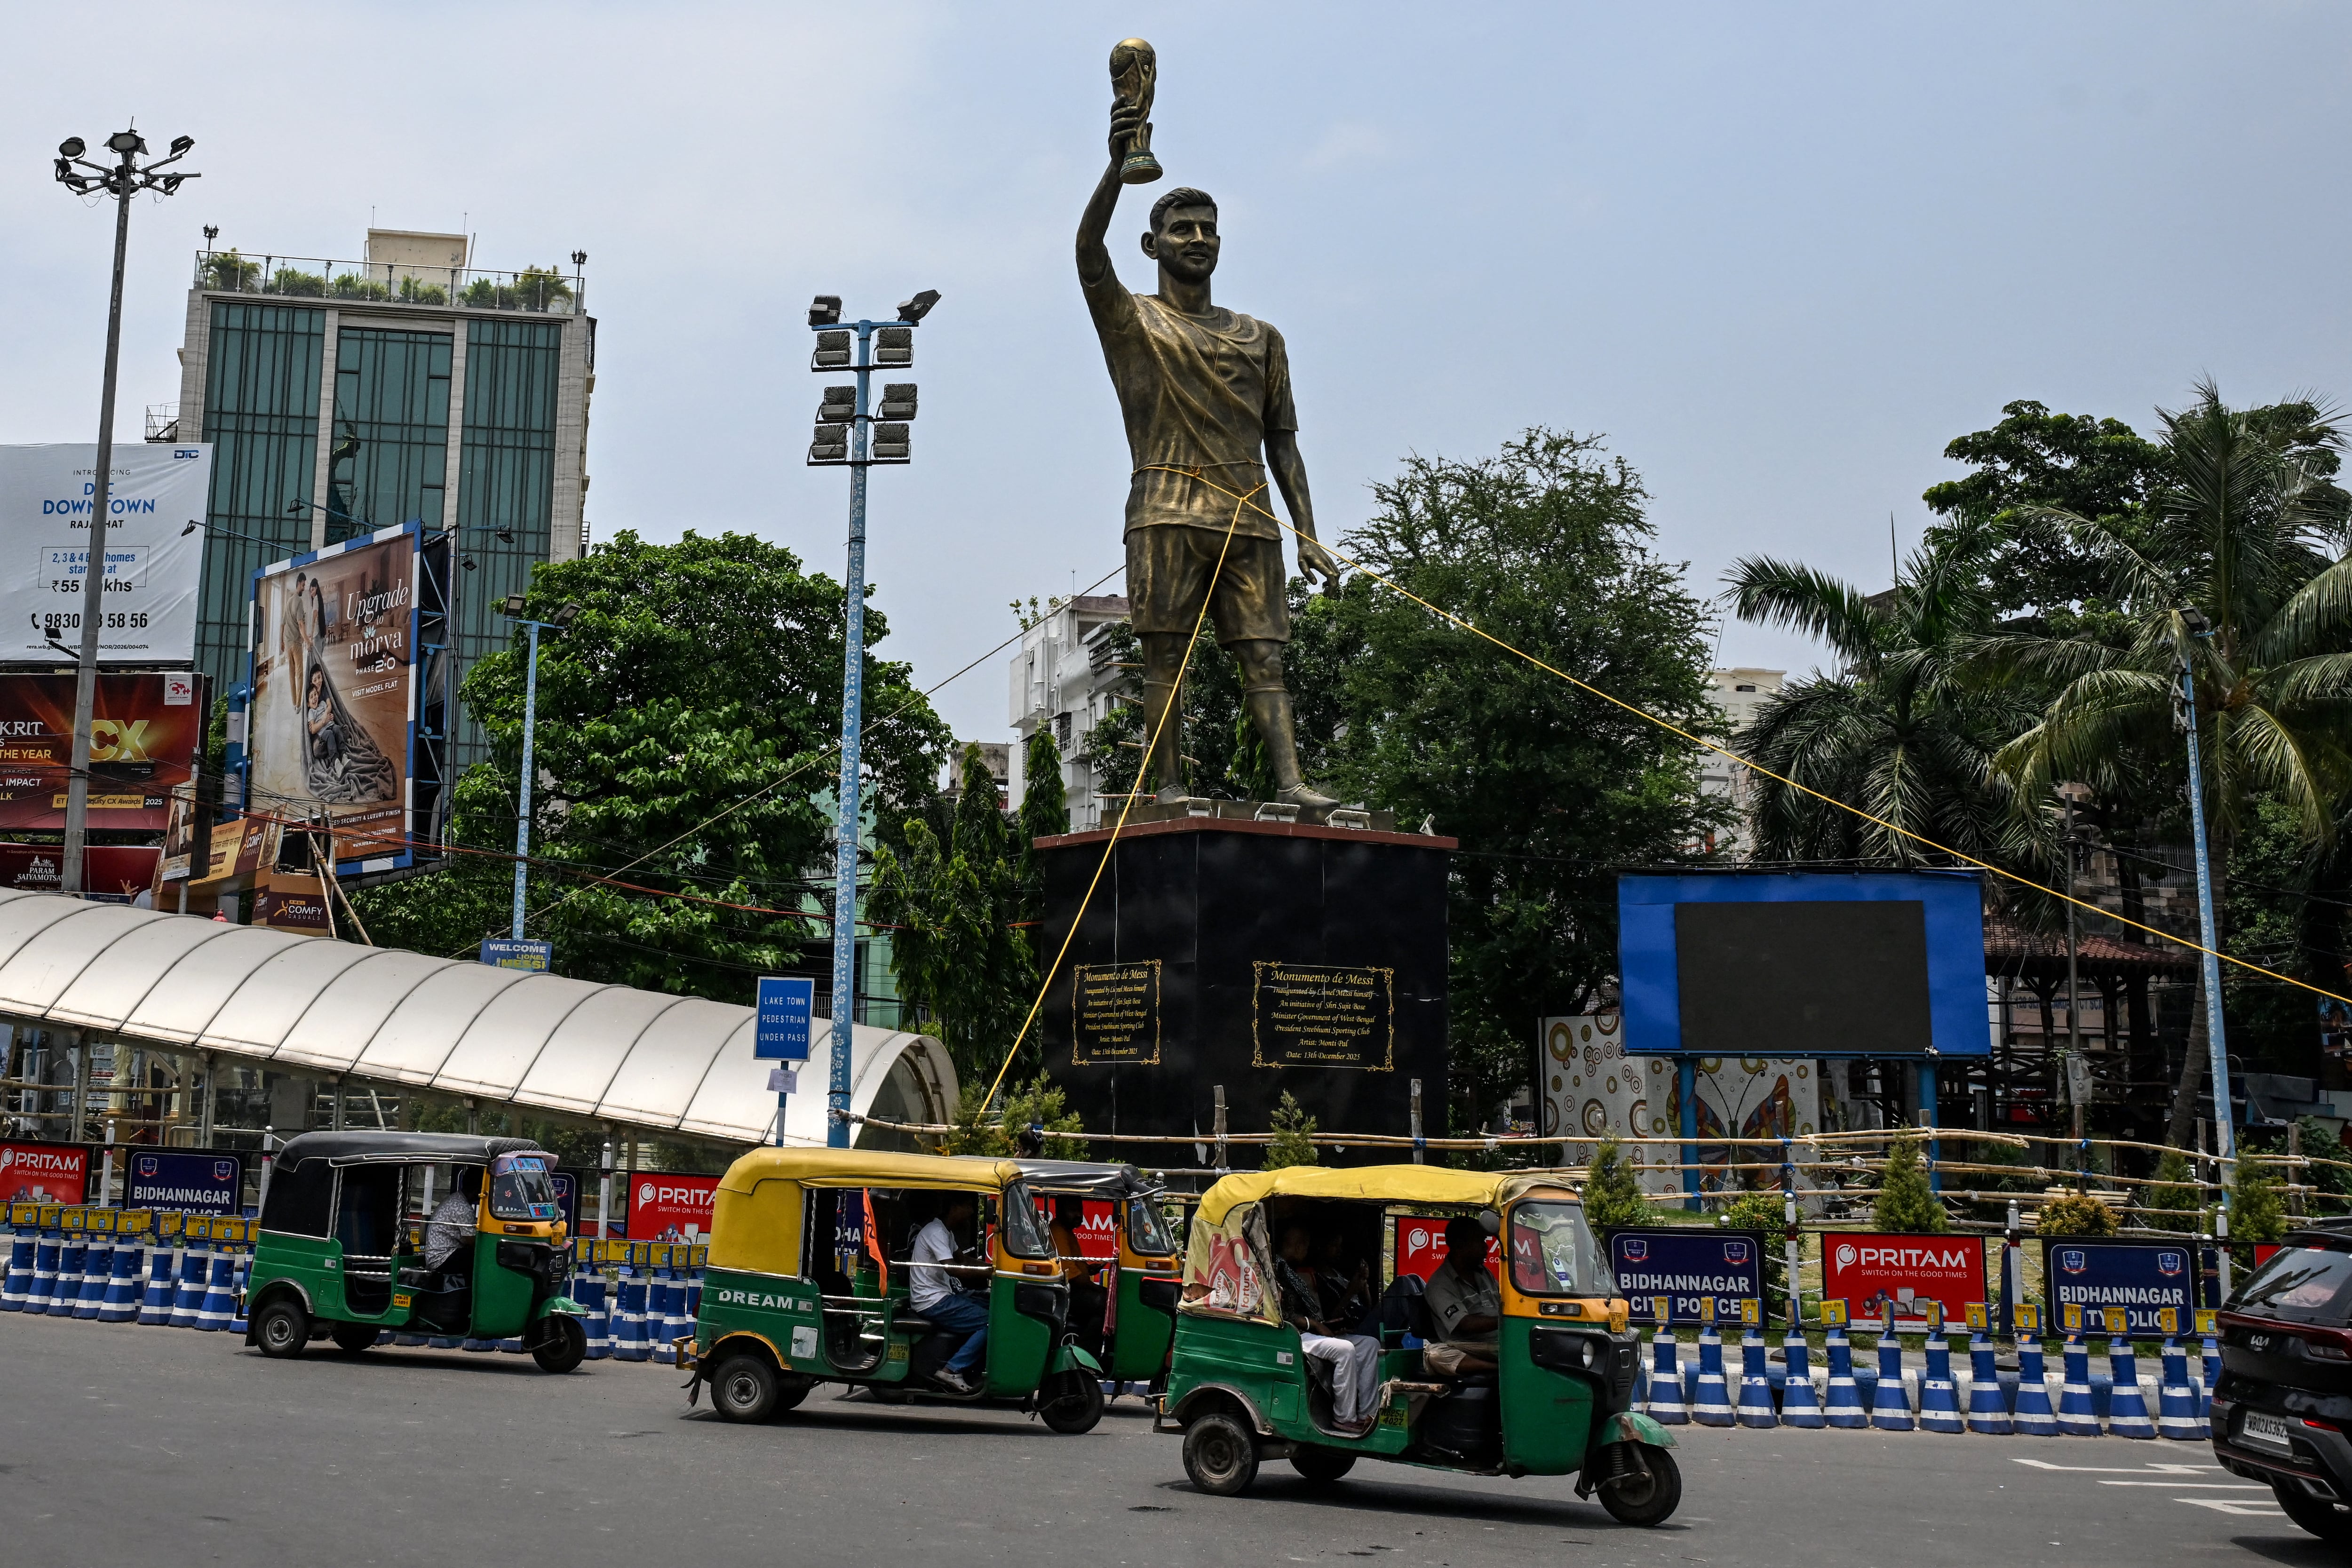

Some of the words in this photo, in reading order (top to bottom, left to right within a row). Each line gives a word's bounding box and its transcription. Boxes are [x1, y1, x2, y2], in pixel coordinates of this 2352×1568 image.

[62, 553, 67, 562] 3
[70, 553, 76, 562] &
[78, 553, 84, 562] 4
[105, 552, 135, 562] homes
[108, 564, 117, 573] at
[347, 579, 408, 627] Upgrade
[45, 613, 80, 628] 9830
[107, 613, 126, 628] 58
[130, 613, 148, 628] 56
[376, 615, 384, 625] to
[356, 665, 374, 676] PHASE
[352, 688, 365, 697] VISIT
[366, 684, 384, 693] MODEL
[385, 680, 397, 689] FLAT
[22, 749, 51, 758] YEAR
[247, 832, 263, 849] COMFY
[288, 906, 323, 915] COMFY
[489, 944, 546, 953] WELCOME
[501, 959, 545, 969] MESSI
[1084, 971, 1120, 982] Monumento
[1121, 969, 1128, 980] de
[1129, 968, 1148, 979] Messi
[1271, 971, 1330, 983] Monumento
[1332, 972, 1343, 983] de
[1345, 974, 1375, 985] Messi
[1273, 987, 1307, 996] Inaugurated
[1309, 988, 1316, 997] by
[1353, 989, 1374, 999] himself
[787, 997, 805, 1005] TOWN
[1316, 1001, 1324, 1010] of
[1337, 1002, 1351, 1011] Sujit
[1352, 1002, 1366, 1011] Bose
[763, 1015, 805, 1024] PEDESTRIAN
[1297, 1013, 1331, 1022] Government
[1332, 1014, 1339, 1023] of
[1355, 1015, 1375, 1025] Bengal
[1331, 1027, 1356, 1036] Sporting
[787, 1034, 805, 1042] PASS
[1318, 1051, 1345, 1060] December
[15, 1152, 79, 1171] PRITAM
[134, 1186, 230, 1204] BIDHANNAGAR
[1860, 1248, 1966, 1268] PRITAM
[1241, 1266, 1250, 1308] fortune
[1620, 1274, 1750, 1292] BIDHANNAGAR
[1213, 1275, 1222, 1305] fortune
[2059, 1286, 2184, 1305] BIDHANNAGAR
[719, 1290, 793, 1309] DREAM
[1383, 1416, 1404, 1425] 4027
